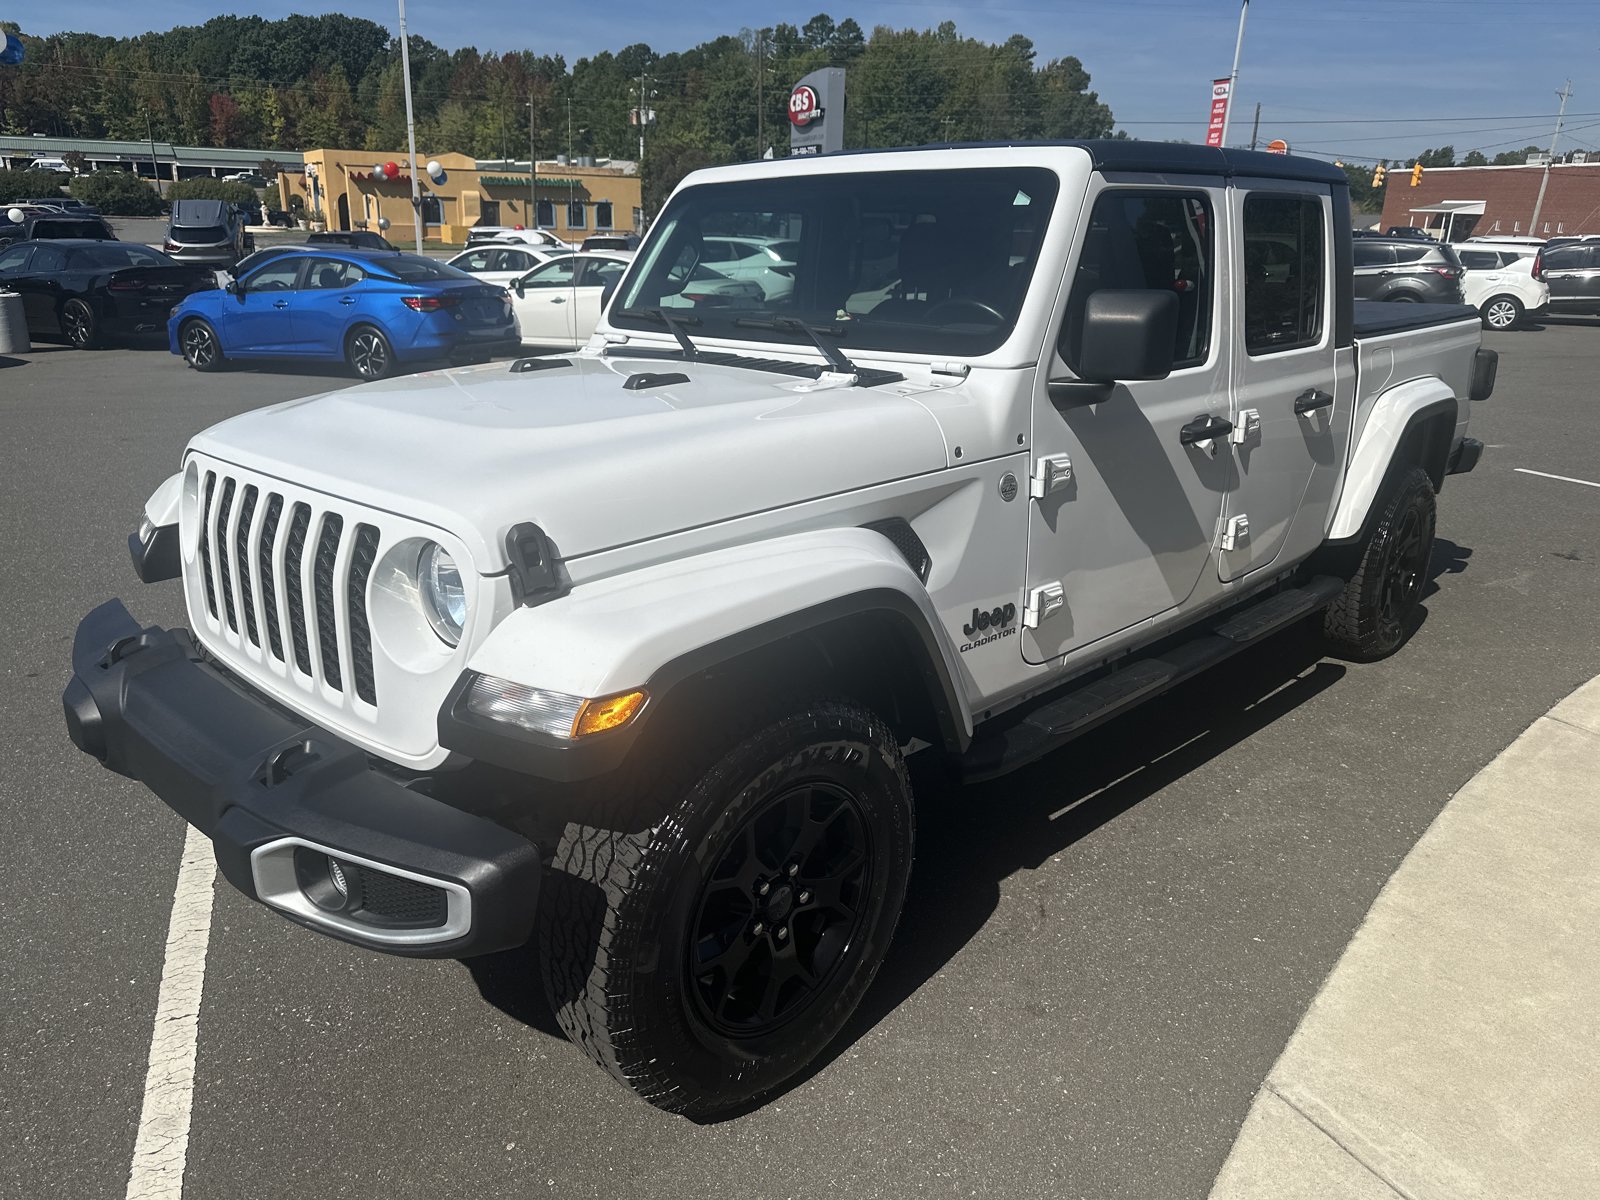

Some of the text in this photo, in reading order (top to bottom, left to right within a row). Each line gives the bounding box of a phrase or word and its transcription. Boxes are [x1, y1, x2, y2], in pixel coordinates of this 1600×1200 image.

[790, 91, 809, 112] CBS
[523, 177, 583, 188] RSTAURANT
[963, 602, 1016, 636] Jeep
[960, 627, 1016, 653] GLADIATOR
